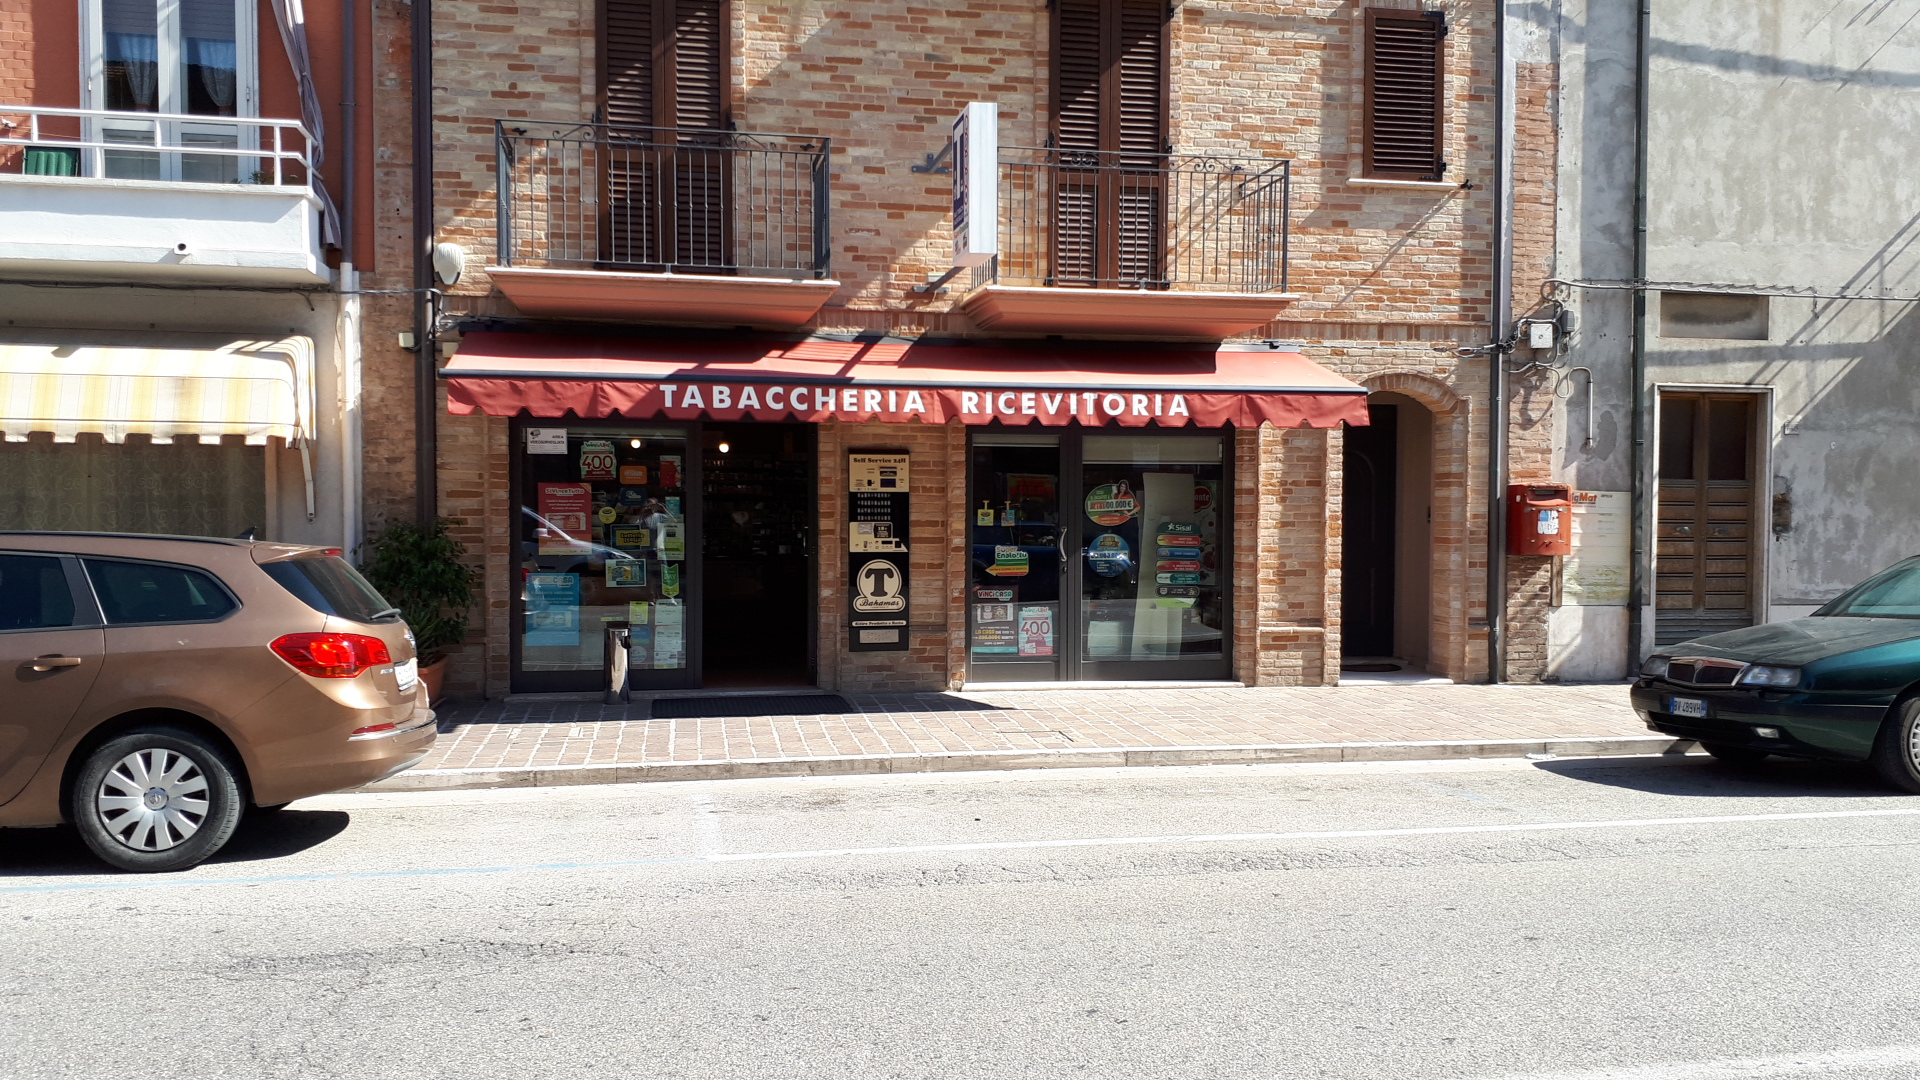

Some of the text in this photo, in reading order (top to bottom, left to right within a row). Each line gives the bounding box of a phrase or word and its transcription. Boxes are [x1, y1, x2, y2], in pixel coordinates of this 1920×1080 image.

[659, 384, 1189, 416] TABACCHERIA RICEVITORIA
[582, 455, 613, 469] 400
[864, 568, 894, 597] T
[860, 599, 899, 607] Bahamas
[1021, 620, 1050, 635] 400
